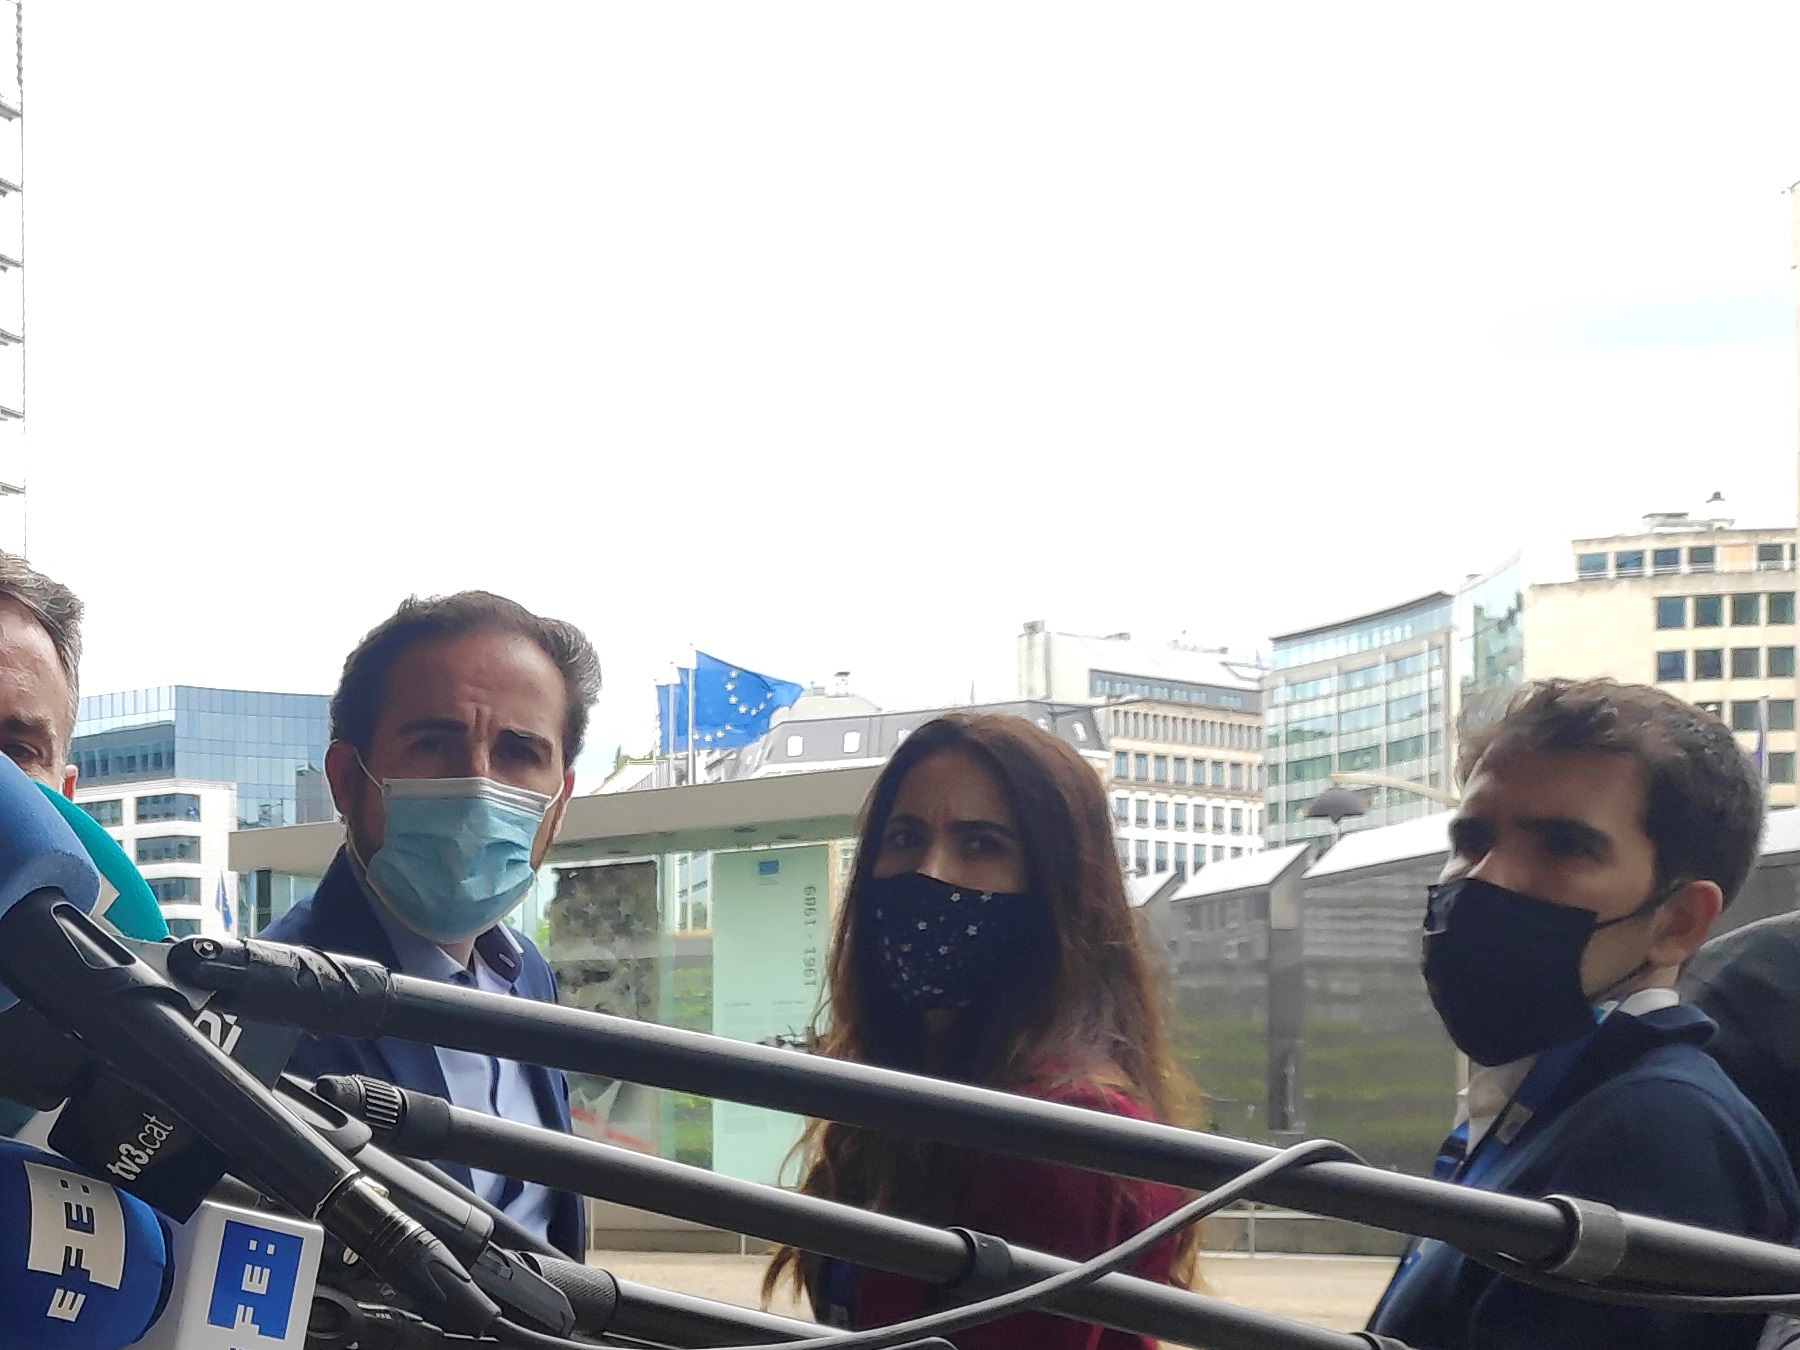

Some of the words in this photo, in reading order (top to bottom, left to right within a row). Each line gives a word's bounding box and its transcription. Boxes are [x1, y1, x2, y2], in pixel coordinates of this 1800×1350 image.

[803, 886, 817, 927] 1989
[803, 947, 816, 986] 1961
[106, 1112, 174, 1181] tv3.cat
